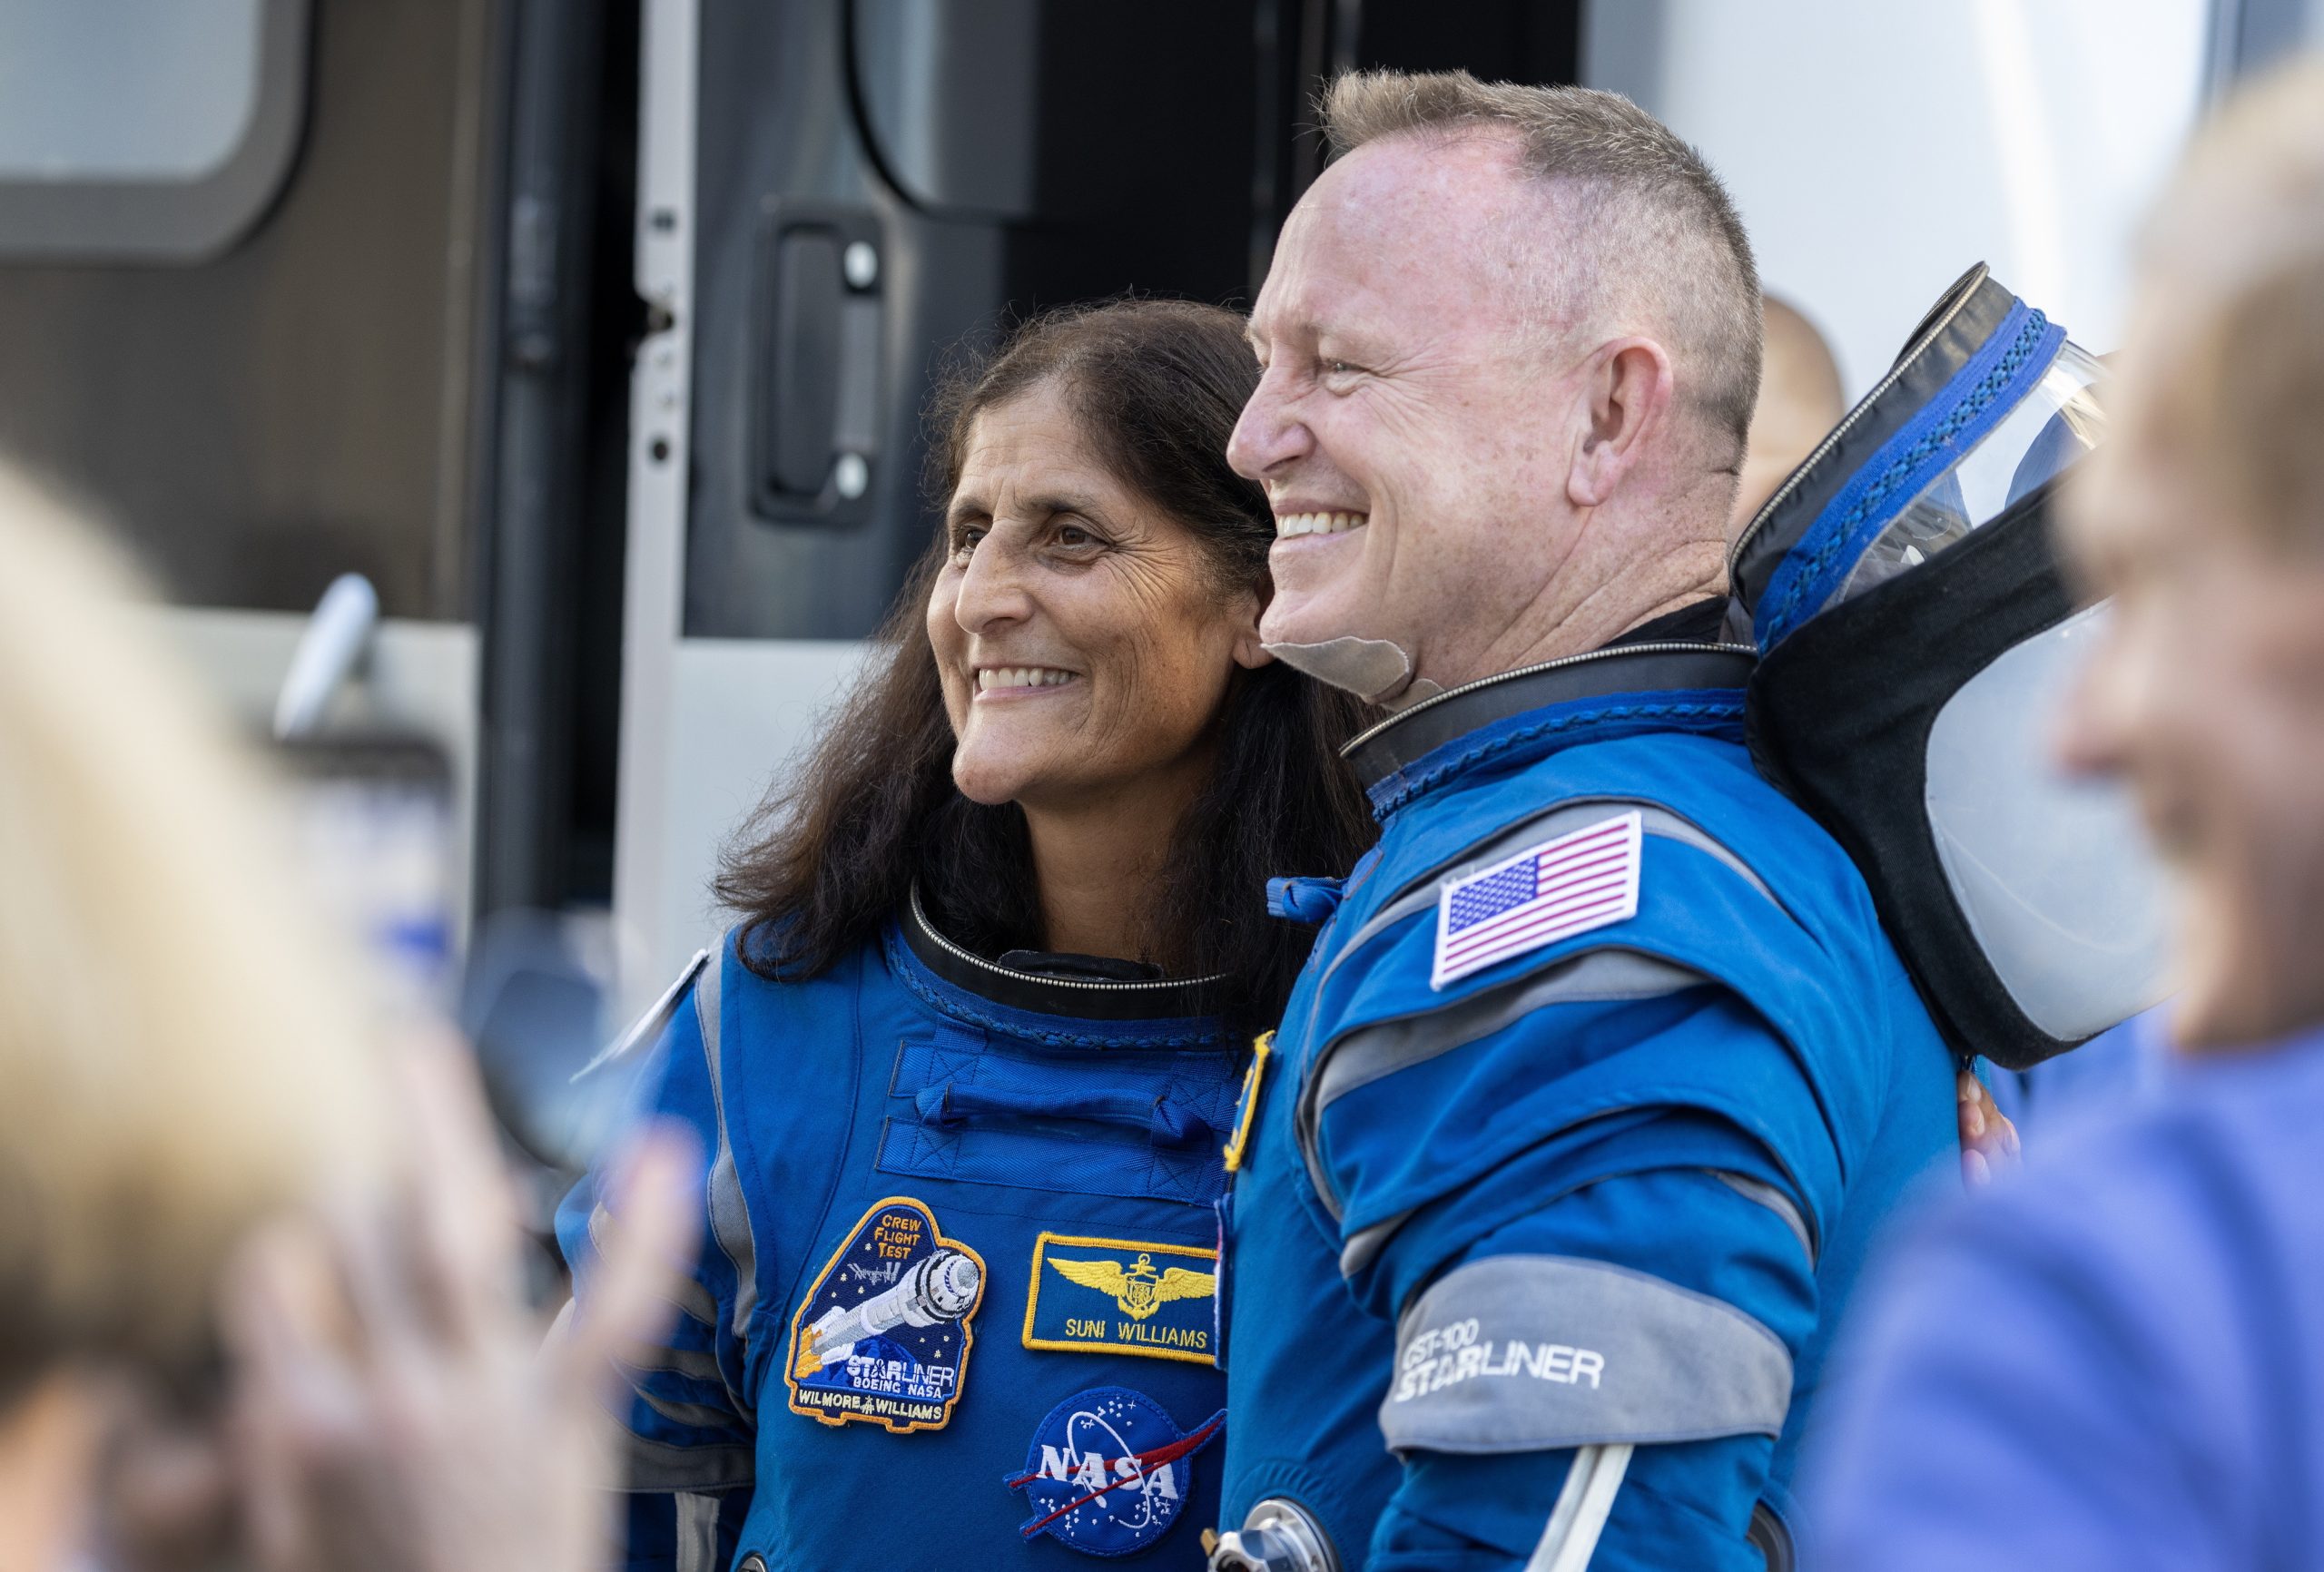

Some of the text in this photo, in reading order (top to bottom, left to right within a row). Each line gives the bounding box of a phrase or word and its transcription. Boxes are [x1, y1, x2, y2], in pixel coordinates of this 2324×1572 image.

[874, 1227, 921, 1246] FLIGHT
[882, 1214, 921, 1232] CREW
[878, 1243, 911, 1260] TEST
[1065, 1318, 1207, 1349] SUNI WILLIAMS
[1402, 1318, 1480, 1371] CST-100
[846, 1354, 955, 1387] STARLINER
[1393, 1340, 1605, 1402] STARLINER
[853, 1376, 942, 1399] BOEING NASA
[799, 1389, 943, 1420] WILMORE WILLIAMS
[1036, 1444, 1179, 1499] NASA
